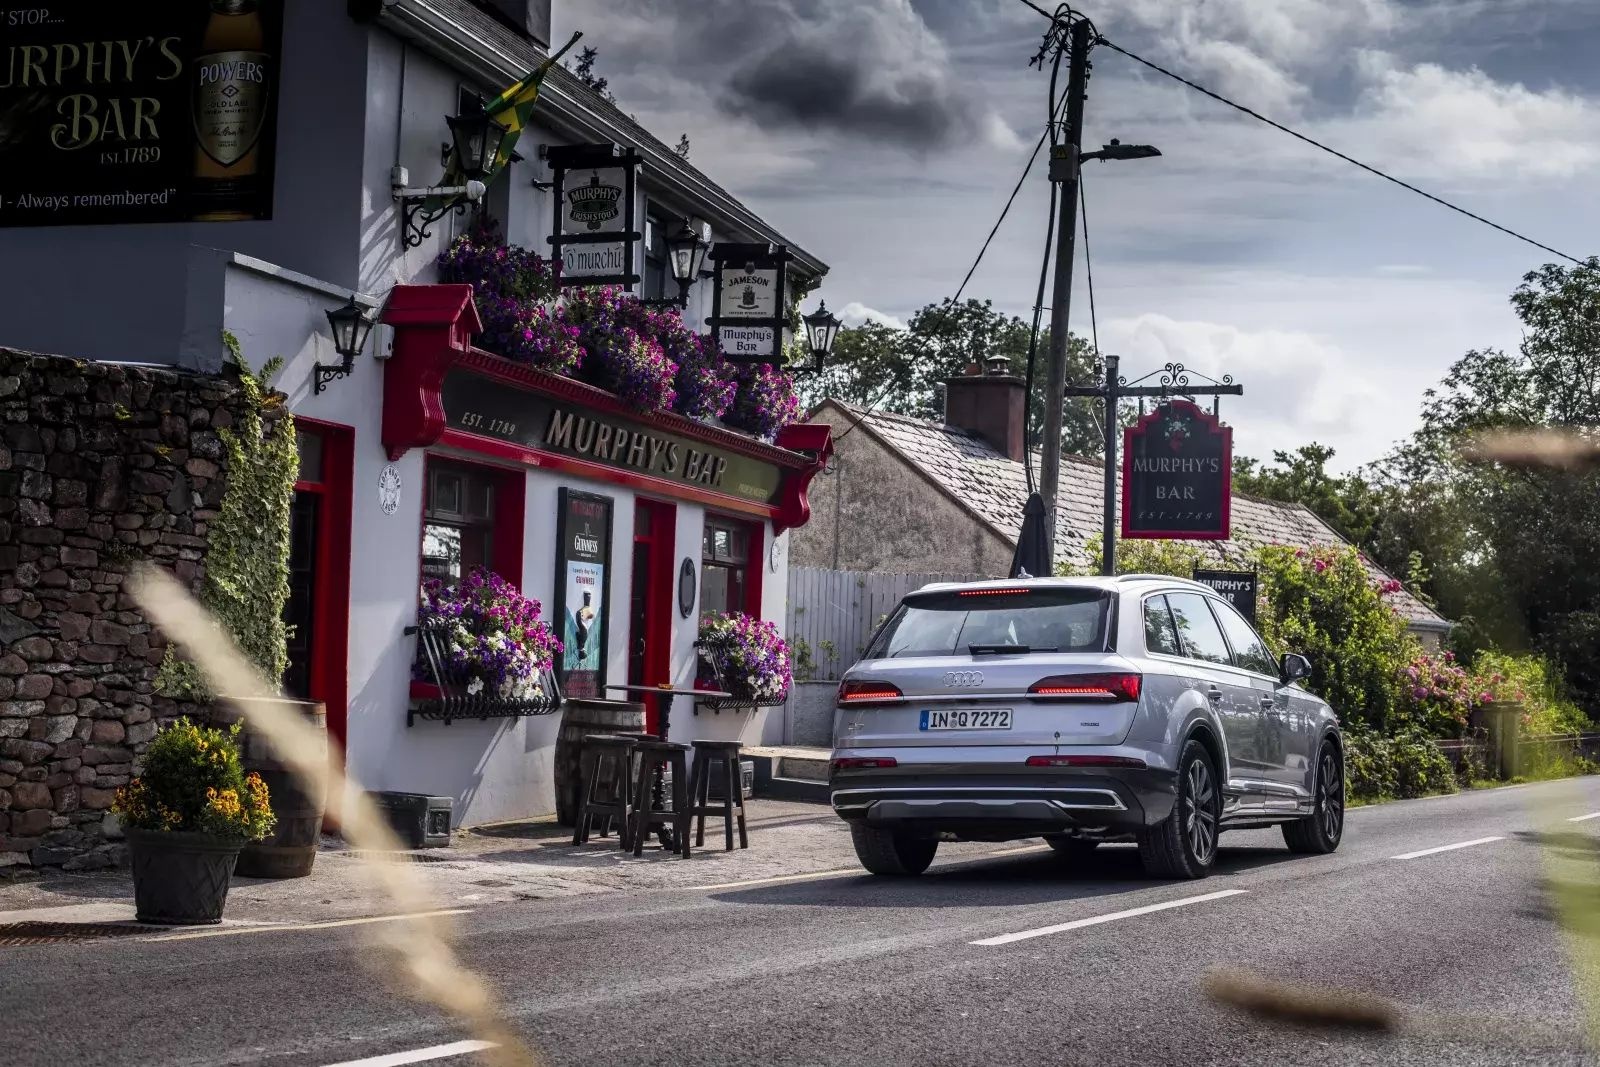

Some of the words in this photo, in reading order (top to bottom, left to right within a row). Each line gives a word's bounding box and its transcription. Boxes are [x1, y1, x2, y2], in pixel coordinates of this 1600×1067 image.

[0, 36, 183, 89] URPHY'S
[199, 60, 264, 87] POWERS
[50, 93, 161, 151] BAR
[16, 193, 69, 211] Always
[728, 275, 769, 287] JAMESON
[461, 411, 484, 429] EST.
[489, 419, 517, 436] 1789
[546, 409, 680, 474] MURPHY'S
[686, 449, 728, 487] BAR
[1133, 456, 1219, 473] MURPHY'S
[1156, 485, 1195, 500] BAR
[574, 535, 598, 553] GUINNESS
[1221, 592, 1235, 603] AR
[971, 711, 1009, 727] 7272
